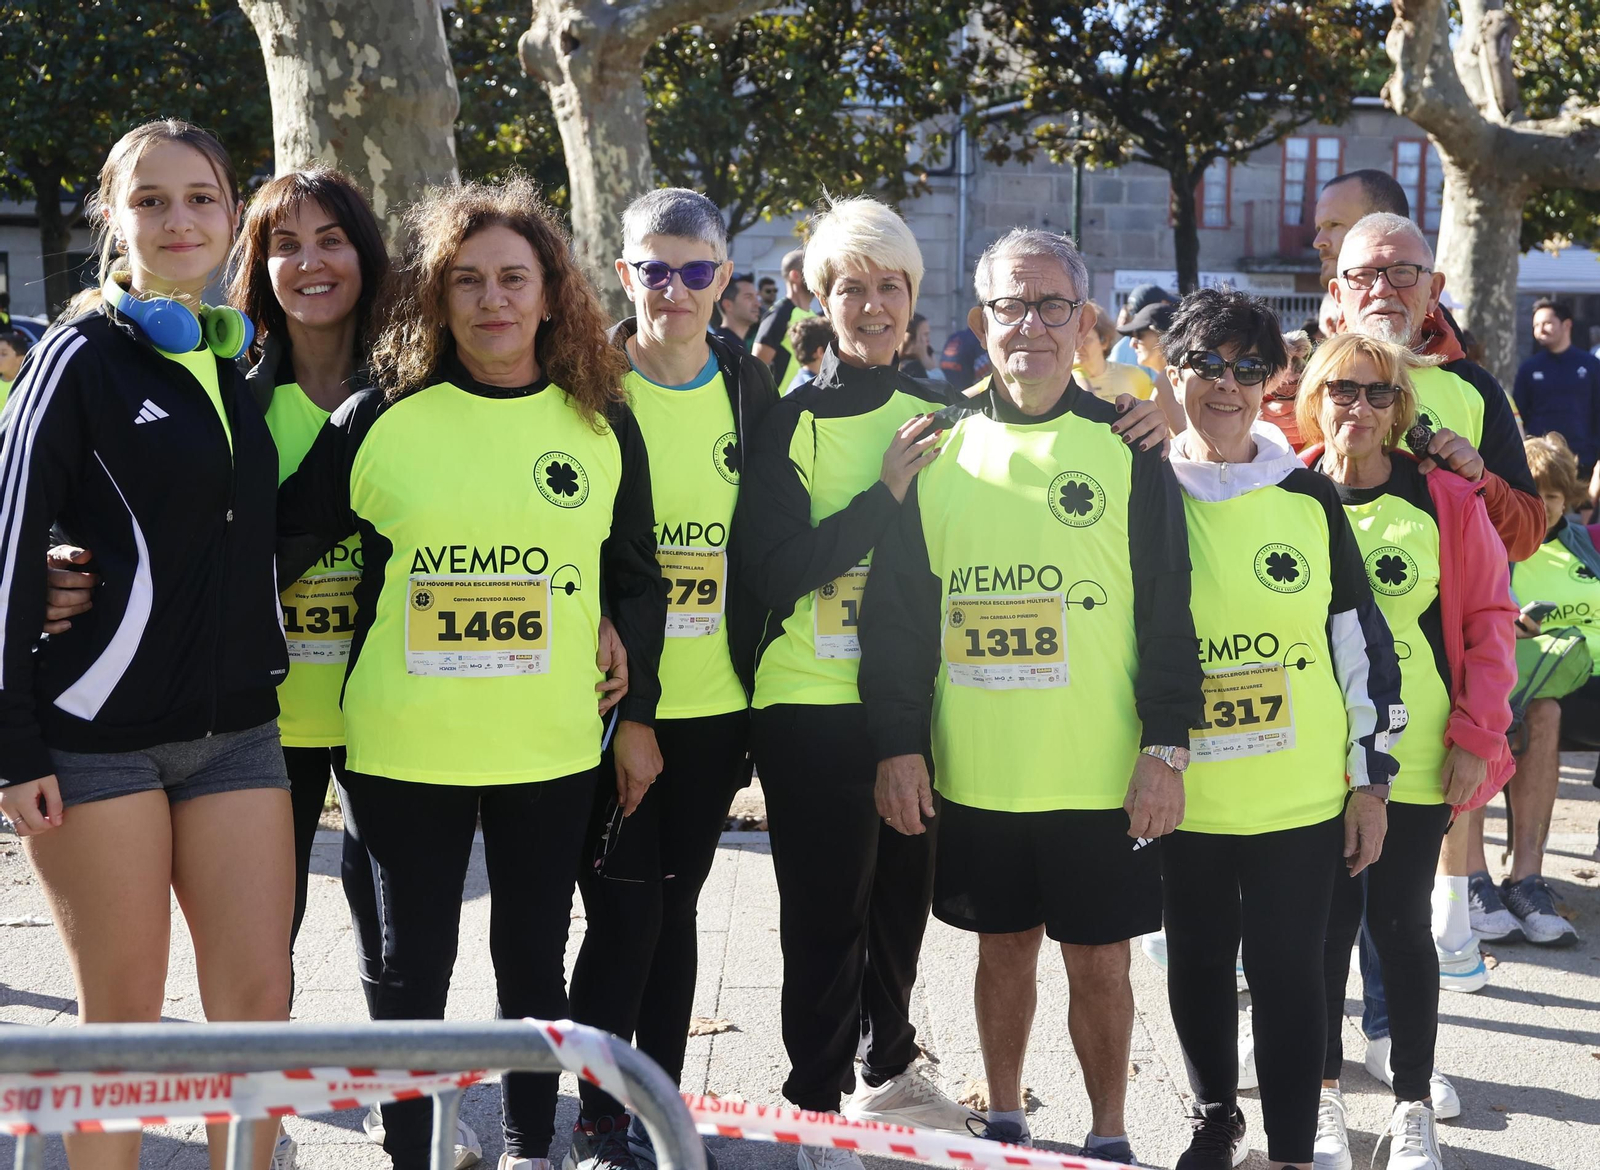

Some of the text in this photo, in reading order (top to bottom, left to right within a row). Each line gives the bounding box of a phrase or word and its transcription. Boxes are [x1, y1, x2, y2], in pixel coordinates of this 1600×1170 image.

[410, 545, 549, 575] AVEMPO
[948, 564, 1063, 595] AVEMPO
[438, 611, 542, 641] 1466
[965, 627, 1058, 657] 1318
[1217, 670, 1250, 679] ESCLEROSE
[1, 1077, 232, 1112] MANTENGA LA DIS
